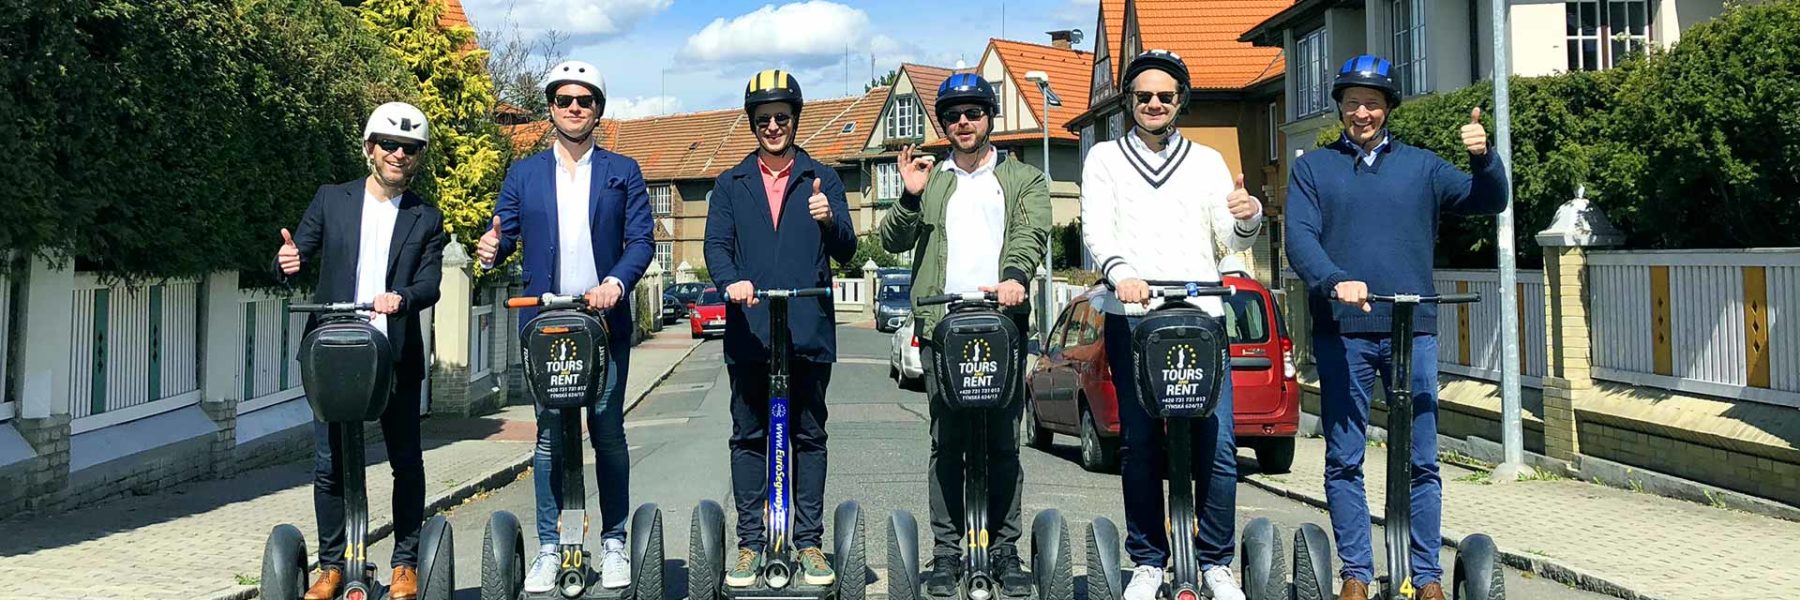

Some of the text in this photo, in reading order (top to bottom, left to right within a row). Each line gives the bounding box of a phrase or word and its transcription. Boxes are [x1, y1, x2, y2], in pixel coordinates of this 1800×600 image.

[546, 360, 583, 373] TOURS
[959, 361, 998, 374] TOURS
[550, 374, 580, 386] RENT
[1162, 368, 1204, 381] TOURS
[963, 375, 994, 388] RENT
[1166, 383, 1199, 396] RENT
[773, 423, 785, 524] www.EuroSegway.
[968, 528, 989, 549] 10
[345, 542, 366, 561] 41
[562, 549, 582, 568] 20
[1400, 575, 1414, 599] 4
